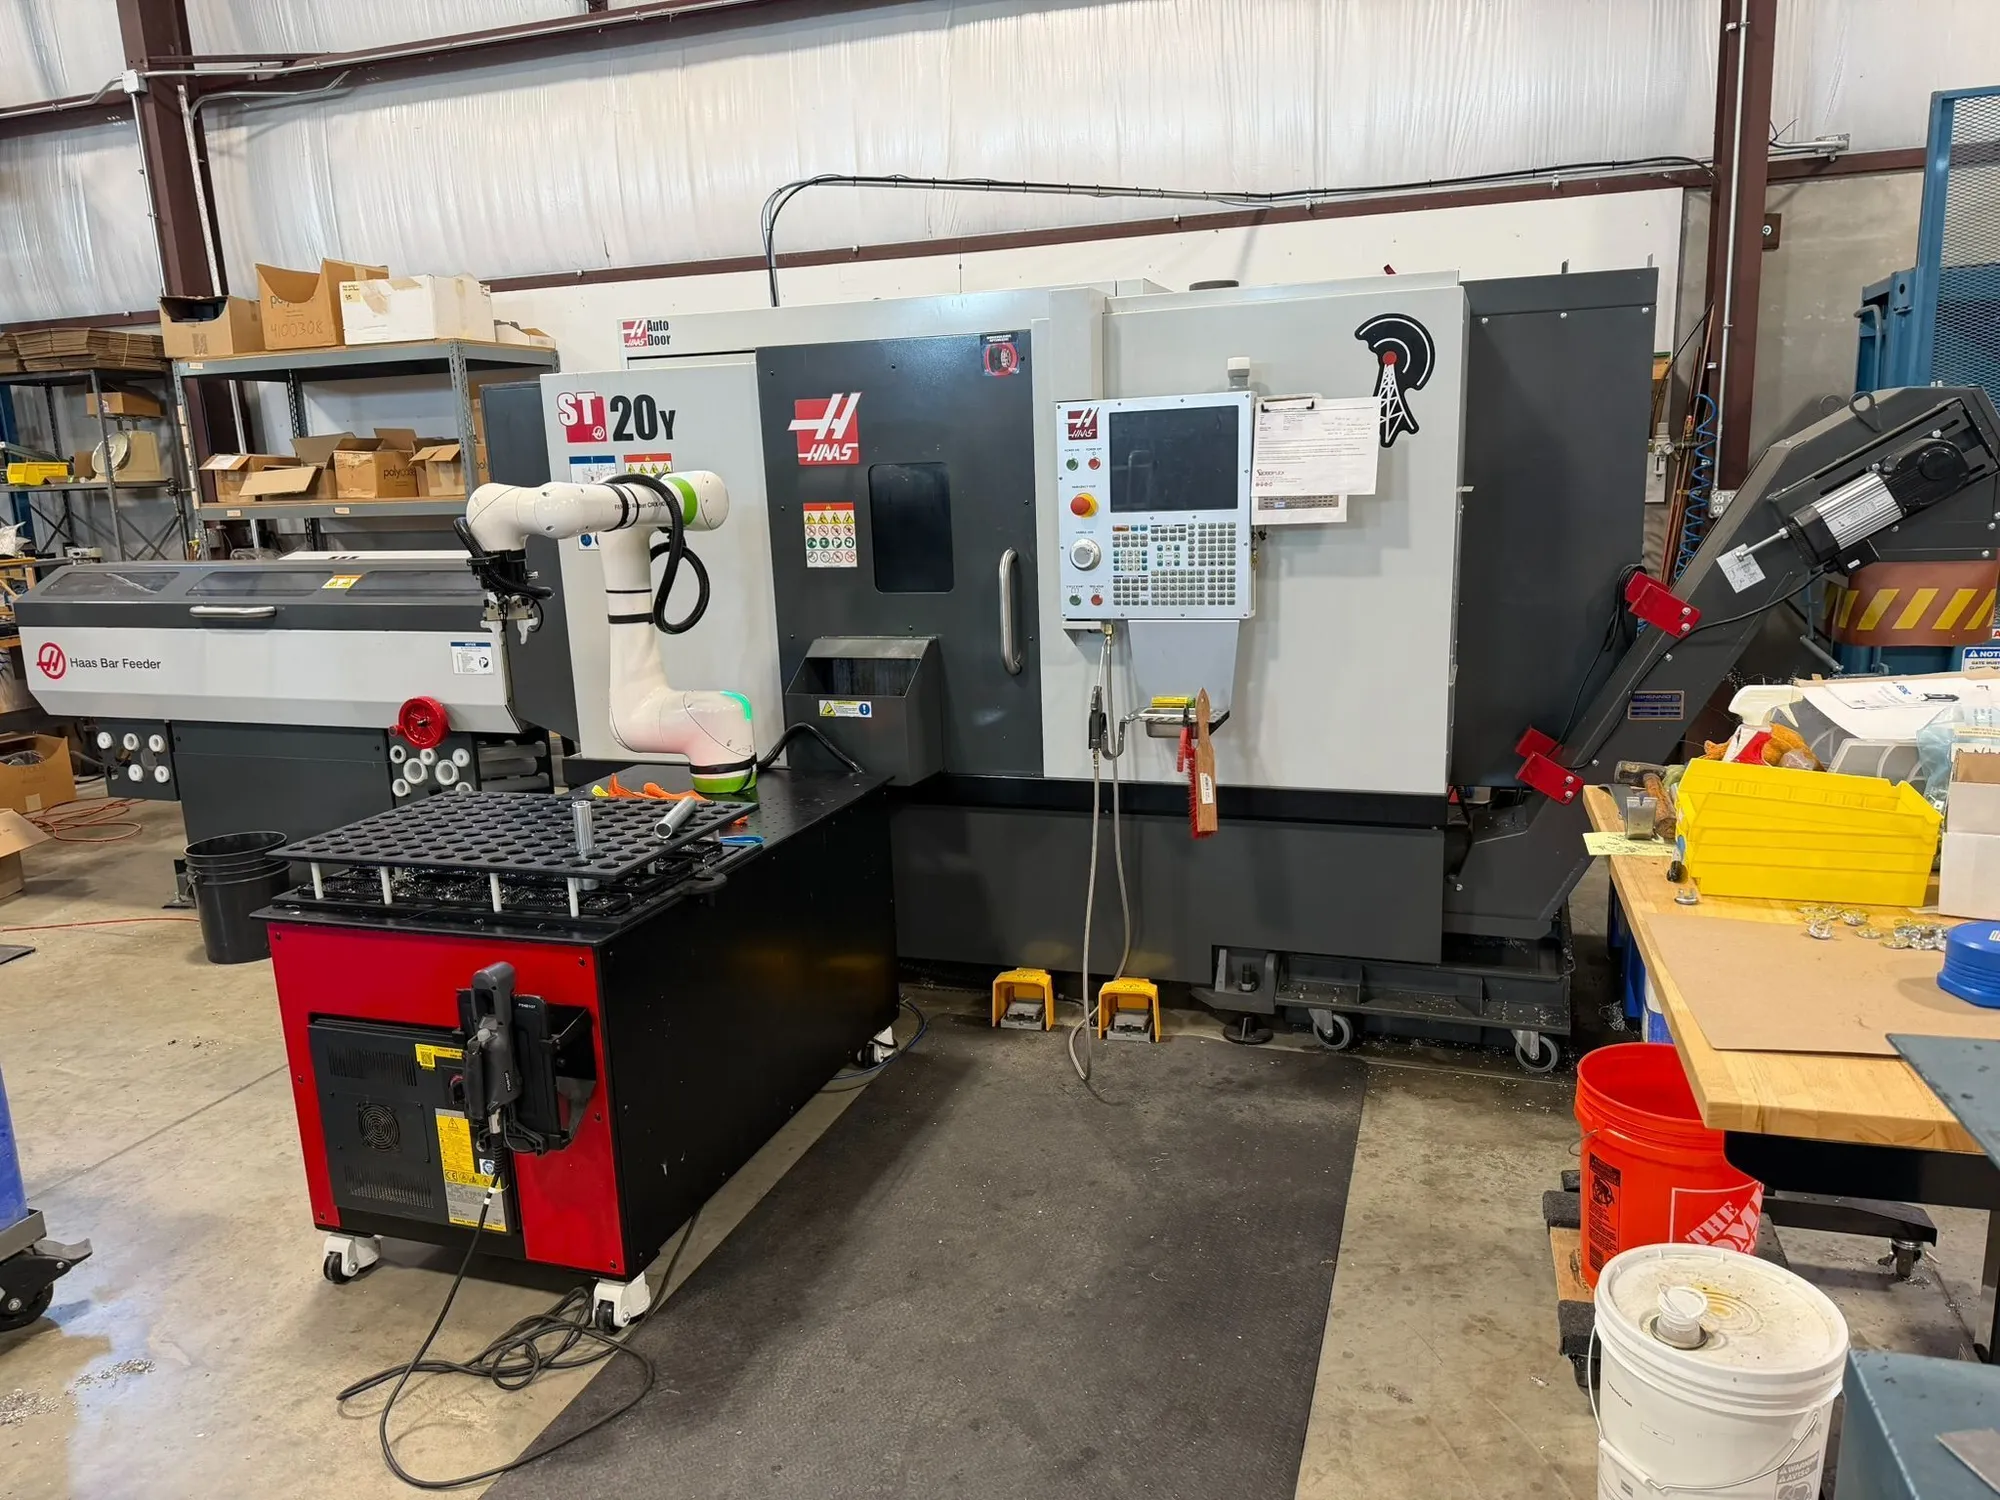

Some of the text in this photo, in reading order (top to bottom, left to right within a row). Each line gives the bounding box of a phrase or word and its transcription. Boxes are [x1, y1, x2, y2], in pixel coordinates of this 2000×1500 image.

[647, 320, 669, 332] Auto
[648, 334, 671, 346] Door
[557, 391, 596, 427] ST
[798, 442, 858, 461] HAAS
[70, 658, 161, 670] Haas Bar Feeder
[1685, 1200, 1740, 1245] THE
